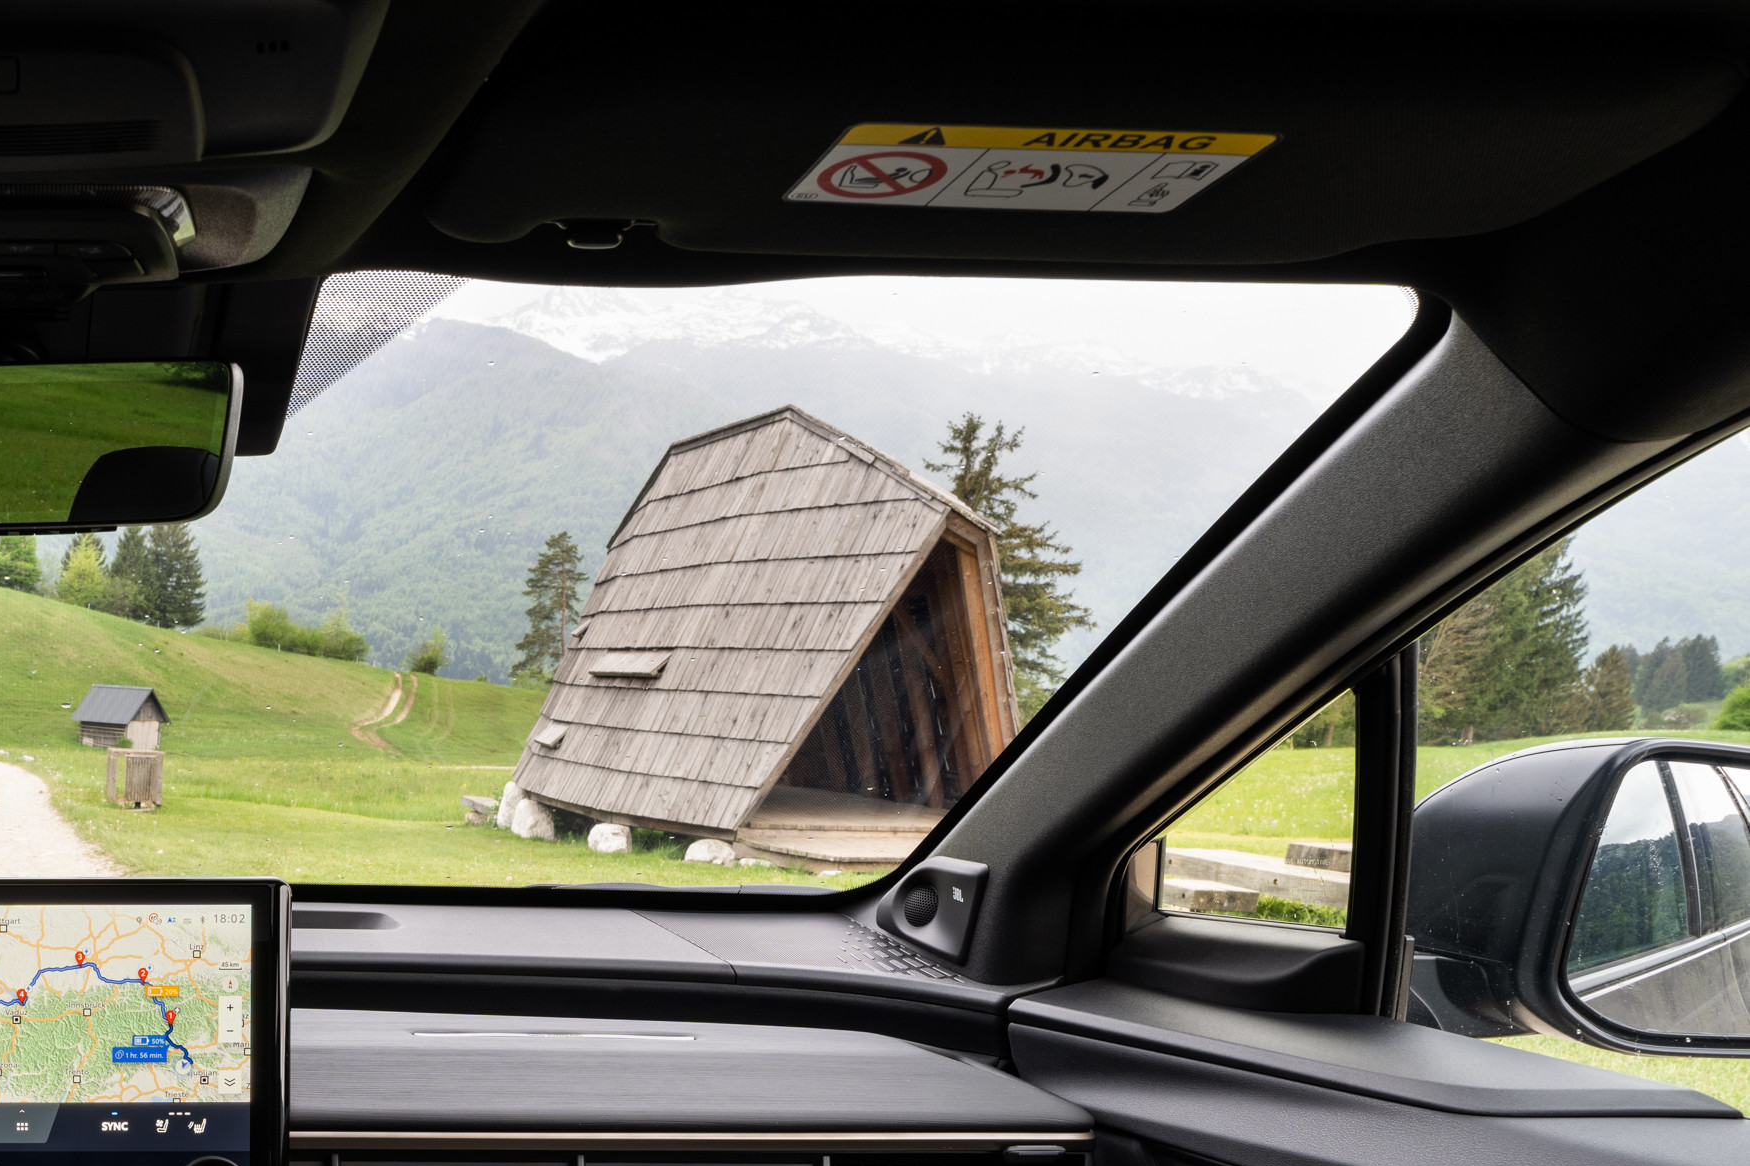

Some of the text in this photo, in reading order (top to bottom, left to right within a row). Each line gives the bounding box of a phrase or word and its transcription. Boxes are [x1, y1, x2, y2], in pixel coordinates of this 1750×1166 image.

[1021, 132, 1218, 151] AIRBAG
[213, 914, 246, 924] 18:02
[77, 952, 83, 960] 3
[230, 960, 240, 968] km
[68, 1001, 106, 1009] Innsbruck
[101, 1121, 129, 1132] SYNC
